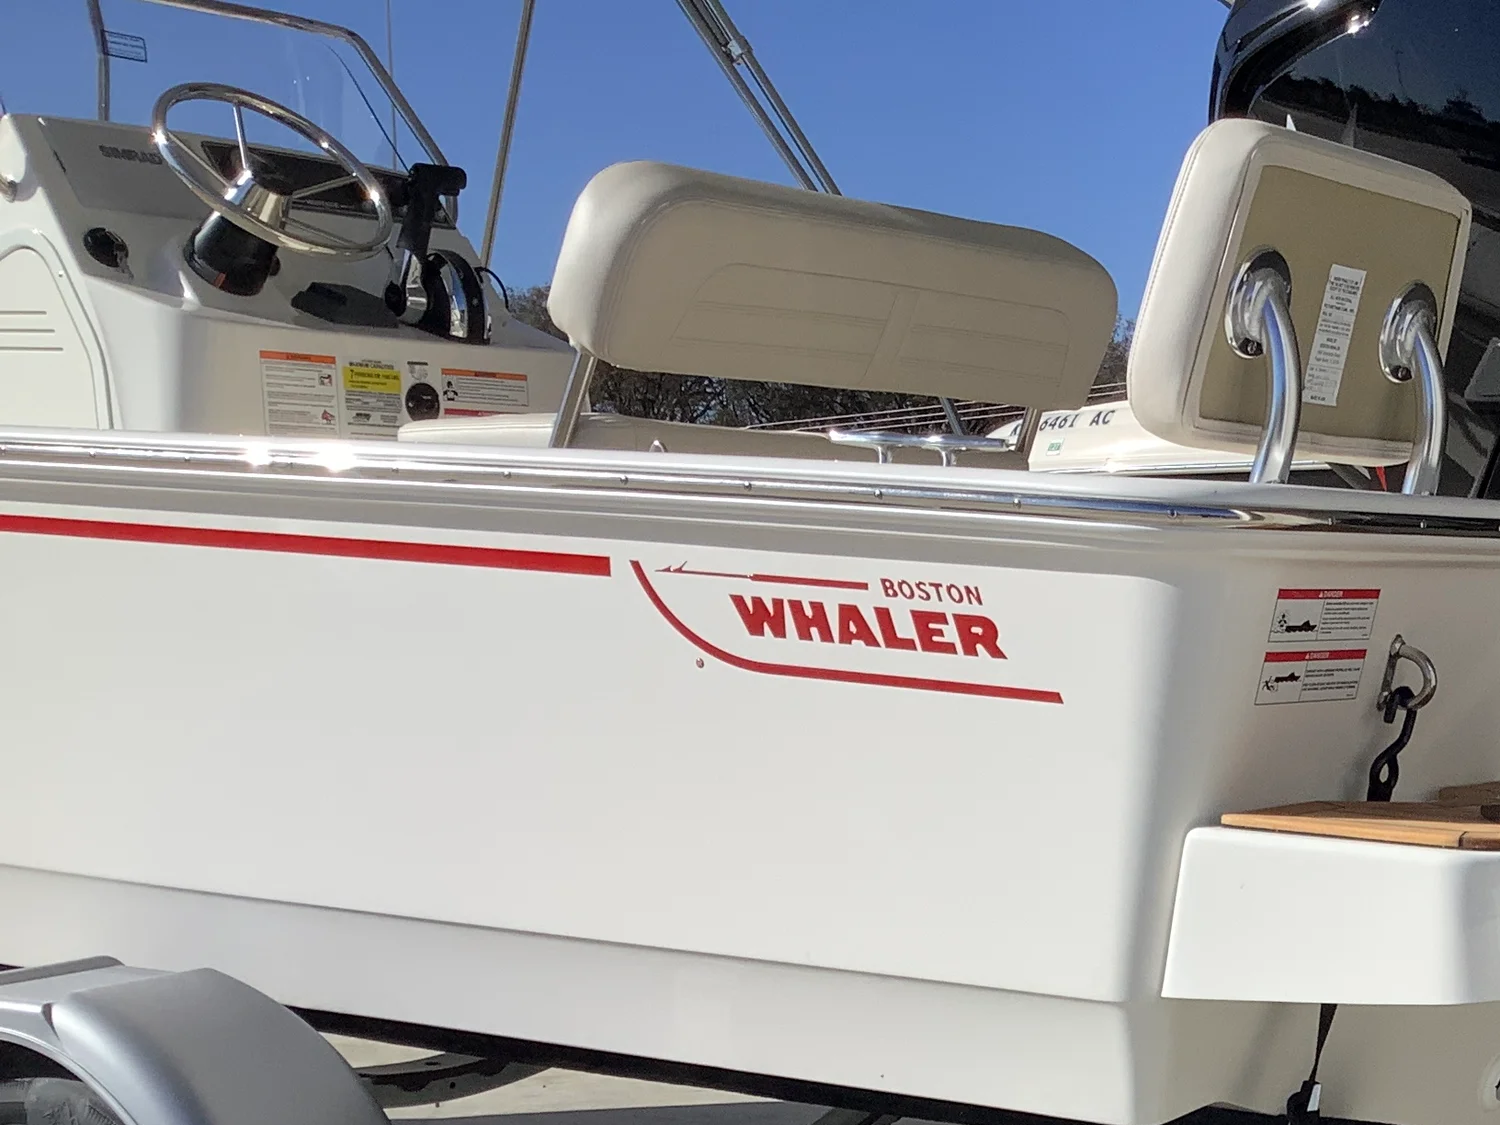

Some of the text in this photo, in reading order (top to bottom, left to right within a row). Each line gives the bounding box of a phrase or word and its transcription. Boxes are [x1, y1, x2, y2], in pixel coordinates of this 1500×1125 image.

[1089, 410, 1116, 427] AC
[880, 578, 983, 605] BOSTON
[728, 594, 1008, 660] WHALER
